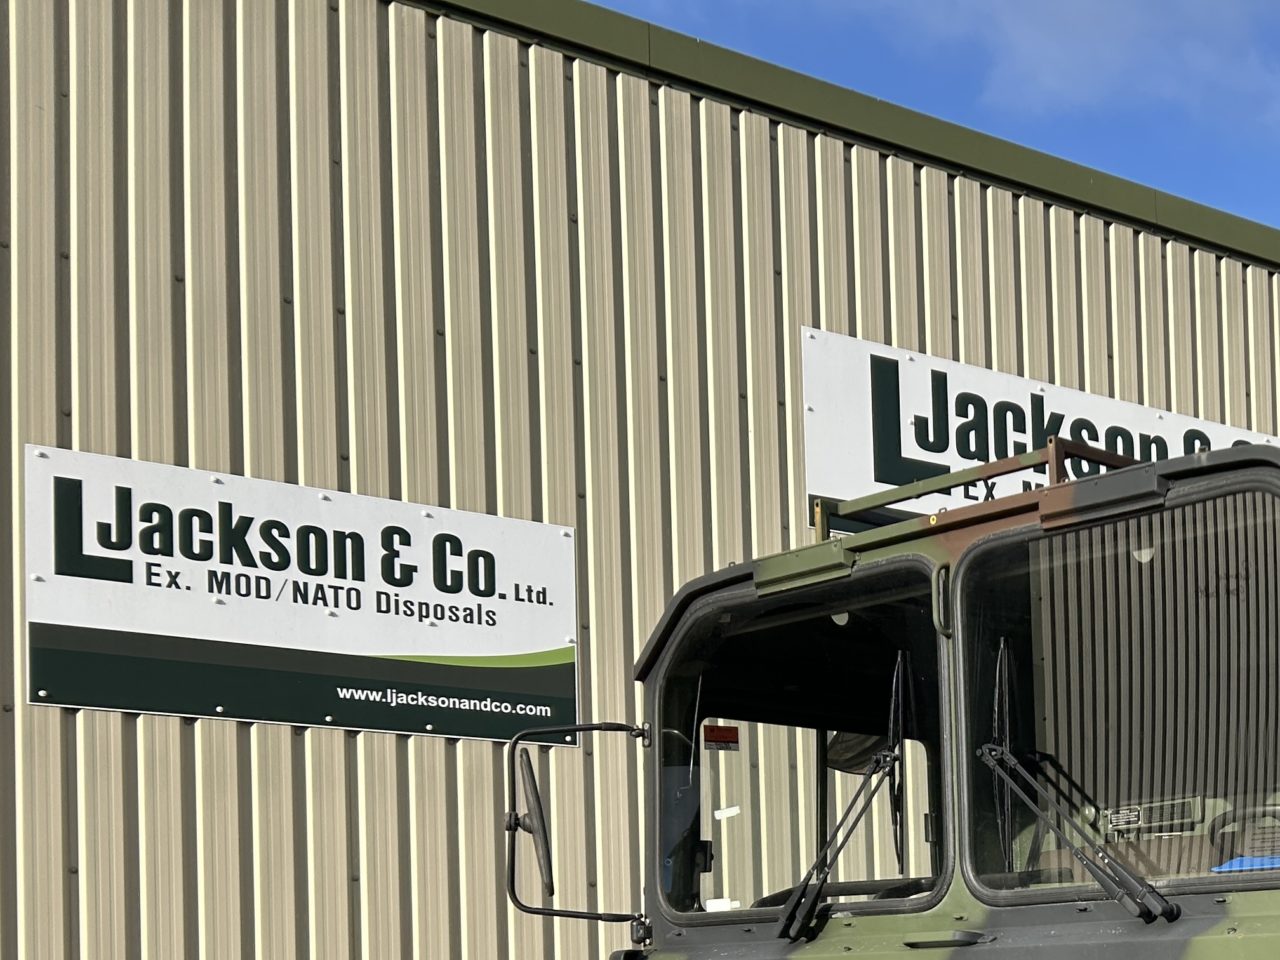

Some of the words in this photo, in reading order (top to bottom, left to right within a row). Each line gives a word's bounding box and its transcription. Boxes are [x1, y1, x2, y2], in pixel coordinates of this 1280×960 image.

[145, 562, 192, 591] Ex.
[207, 569, 362, 611] MOD/NATO
[376, 590, 497, 627] Disposals
[381, 525, 418, 588] &
[432, 533, 507, 598] Co.
[514, 583, 554, 606] Ltd.
[336, 687, 552, 717] www.ljacksonandco.com
